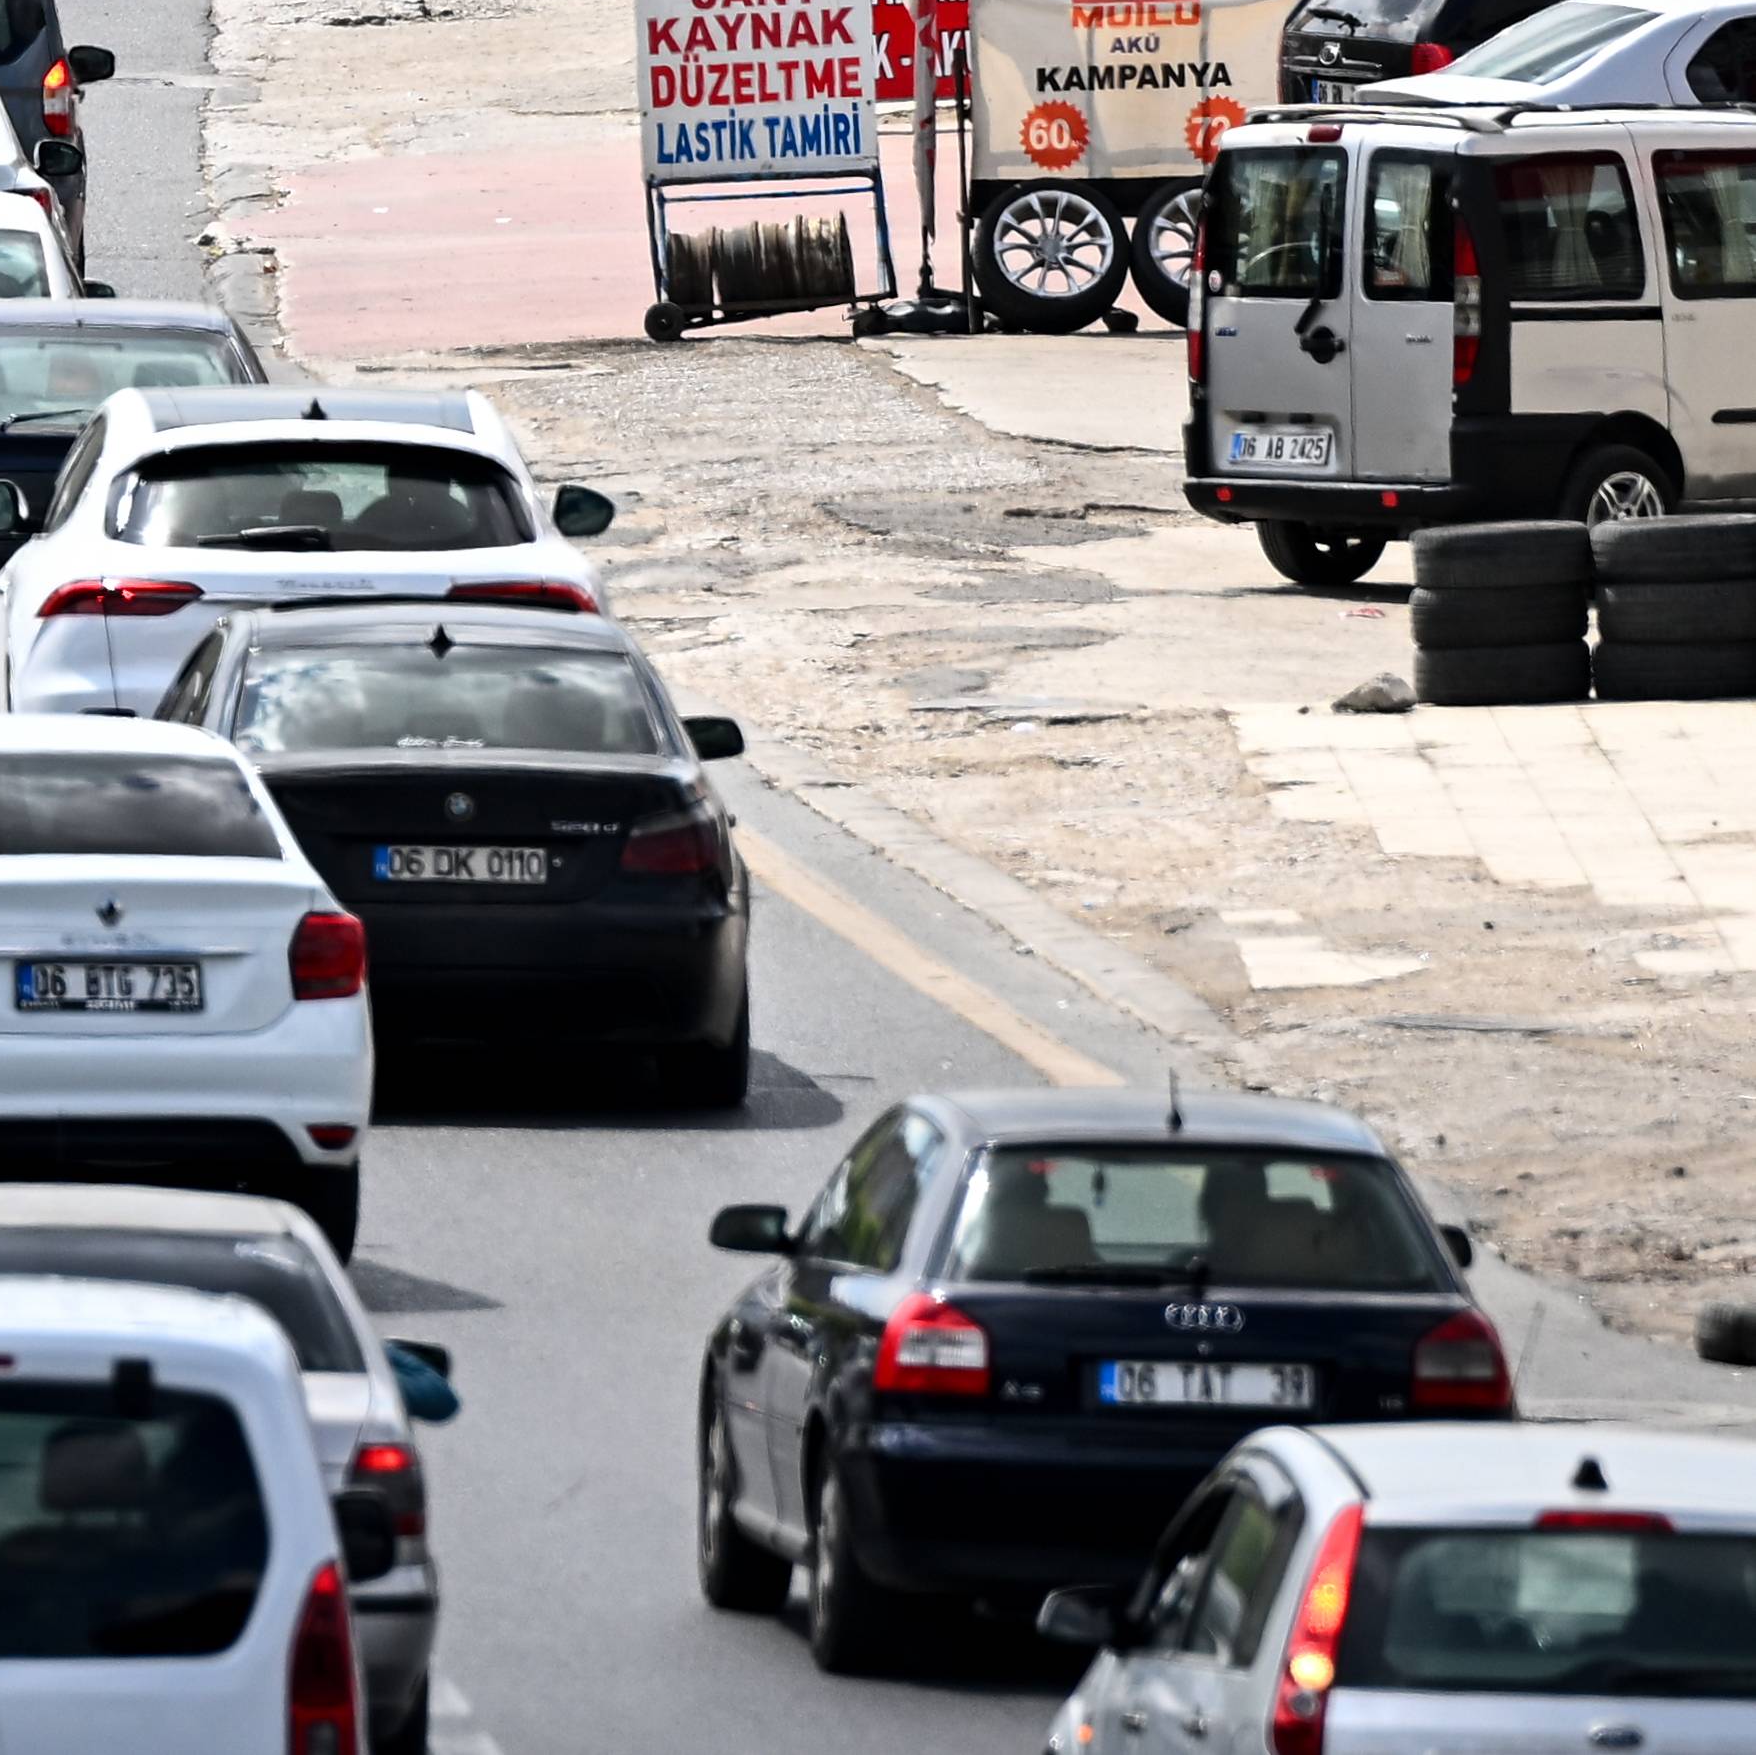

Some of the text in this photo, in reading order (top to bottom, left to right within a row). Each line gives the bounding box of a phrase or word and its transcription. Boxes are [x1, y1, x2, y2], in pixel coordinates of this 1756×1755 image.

[646, 6, 856, 55] KAYNAK
[1109, 34, 1161, 54] AKÜ
[649, 53, 864, 109] DÜZELTME
[1035, 62, 1233, 93] KAMPANYA
[656, 102, 863, 165] LASTİK TAMİRİ
[1028, 117, 1072, 151] 60
[1264, 436, 1284, 460] AB
[387, 846, 545, 879] 06 DK 0110
[33, 964, 196, 999] 06 BTG 735
[1118, 1362, 1307, 1403] 06 TAT 39
